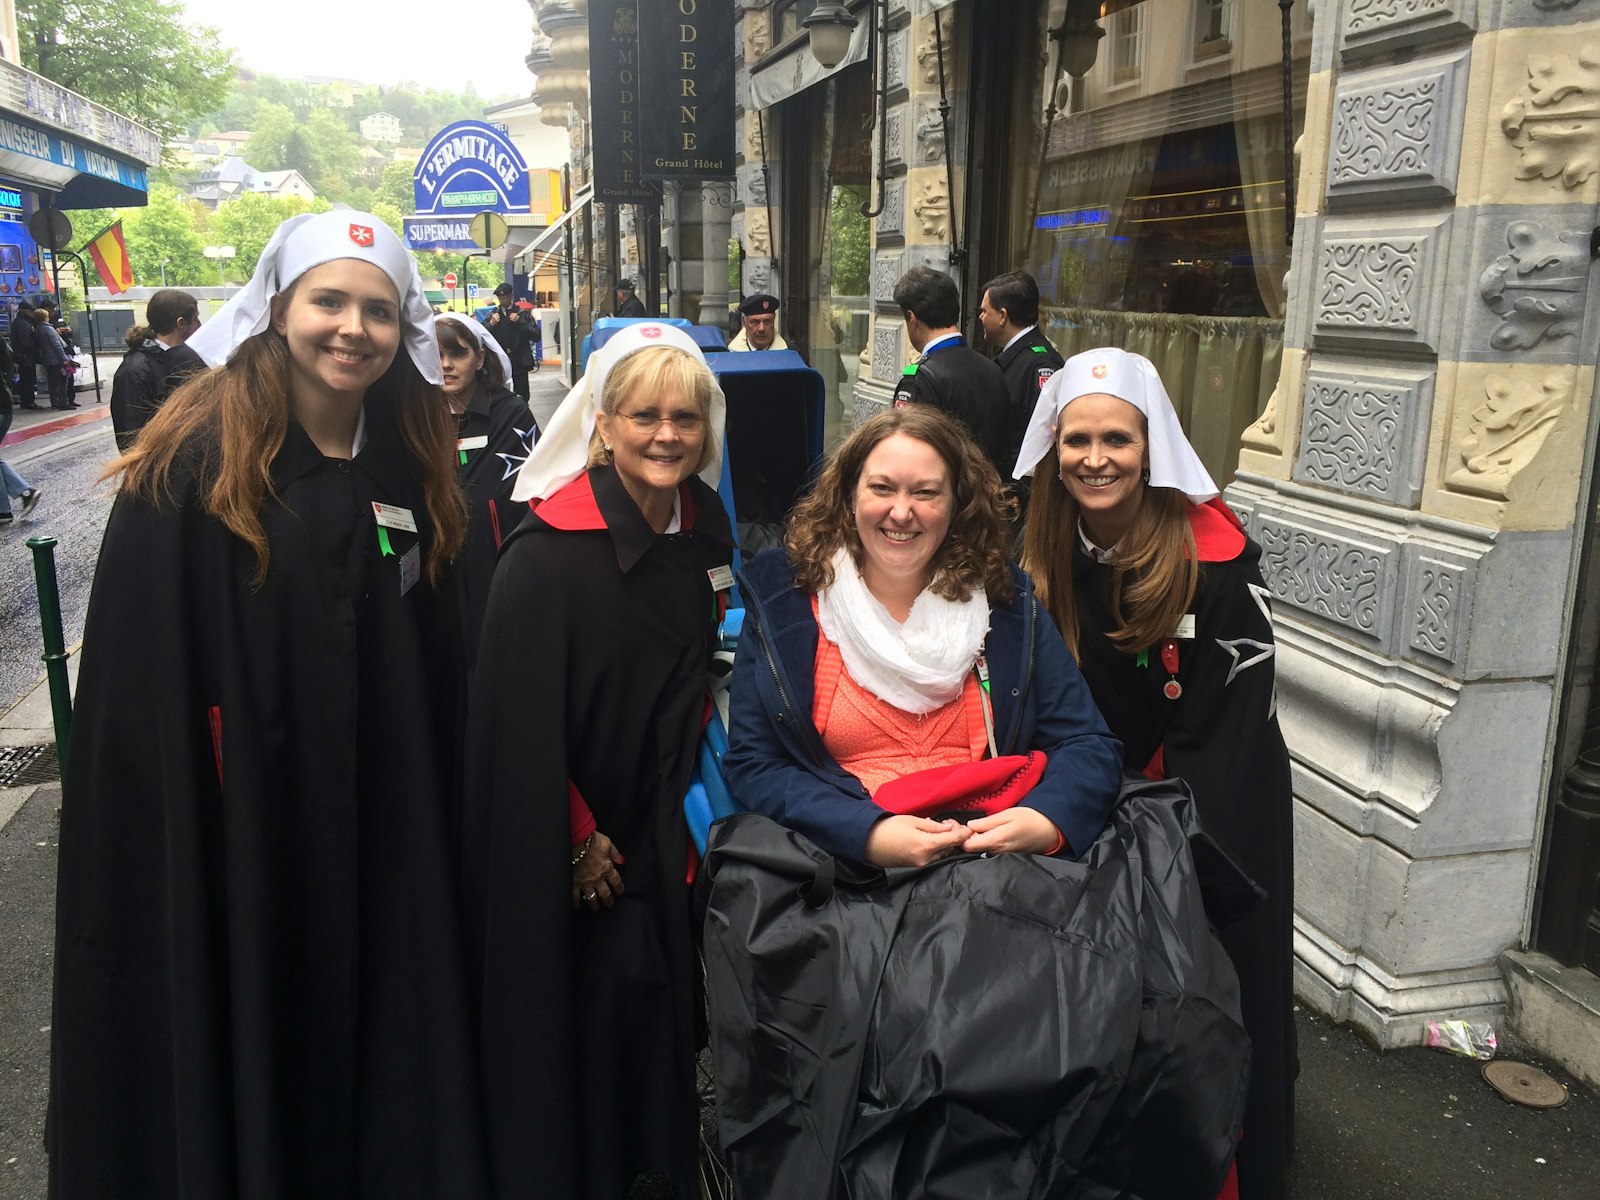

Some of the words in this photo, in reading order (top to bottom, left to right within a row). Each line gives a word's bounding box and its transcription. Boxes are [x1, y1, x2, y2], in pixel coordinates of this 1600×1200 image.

[618, 50, 635, 183] MODERNE
[60, 139, 76, 168] DU
[83, 148, 121, 182] VATICAN
[421, 135, 520, 195] L'ERMITAGE
[655, 158, 689, 168] Grand
[694, 159, 723, 169] Hôtel
[409, 223, 473, 241] SUPERMAR
